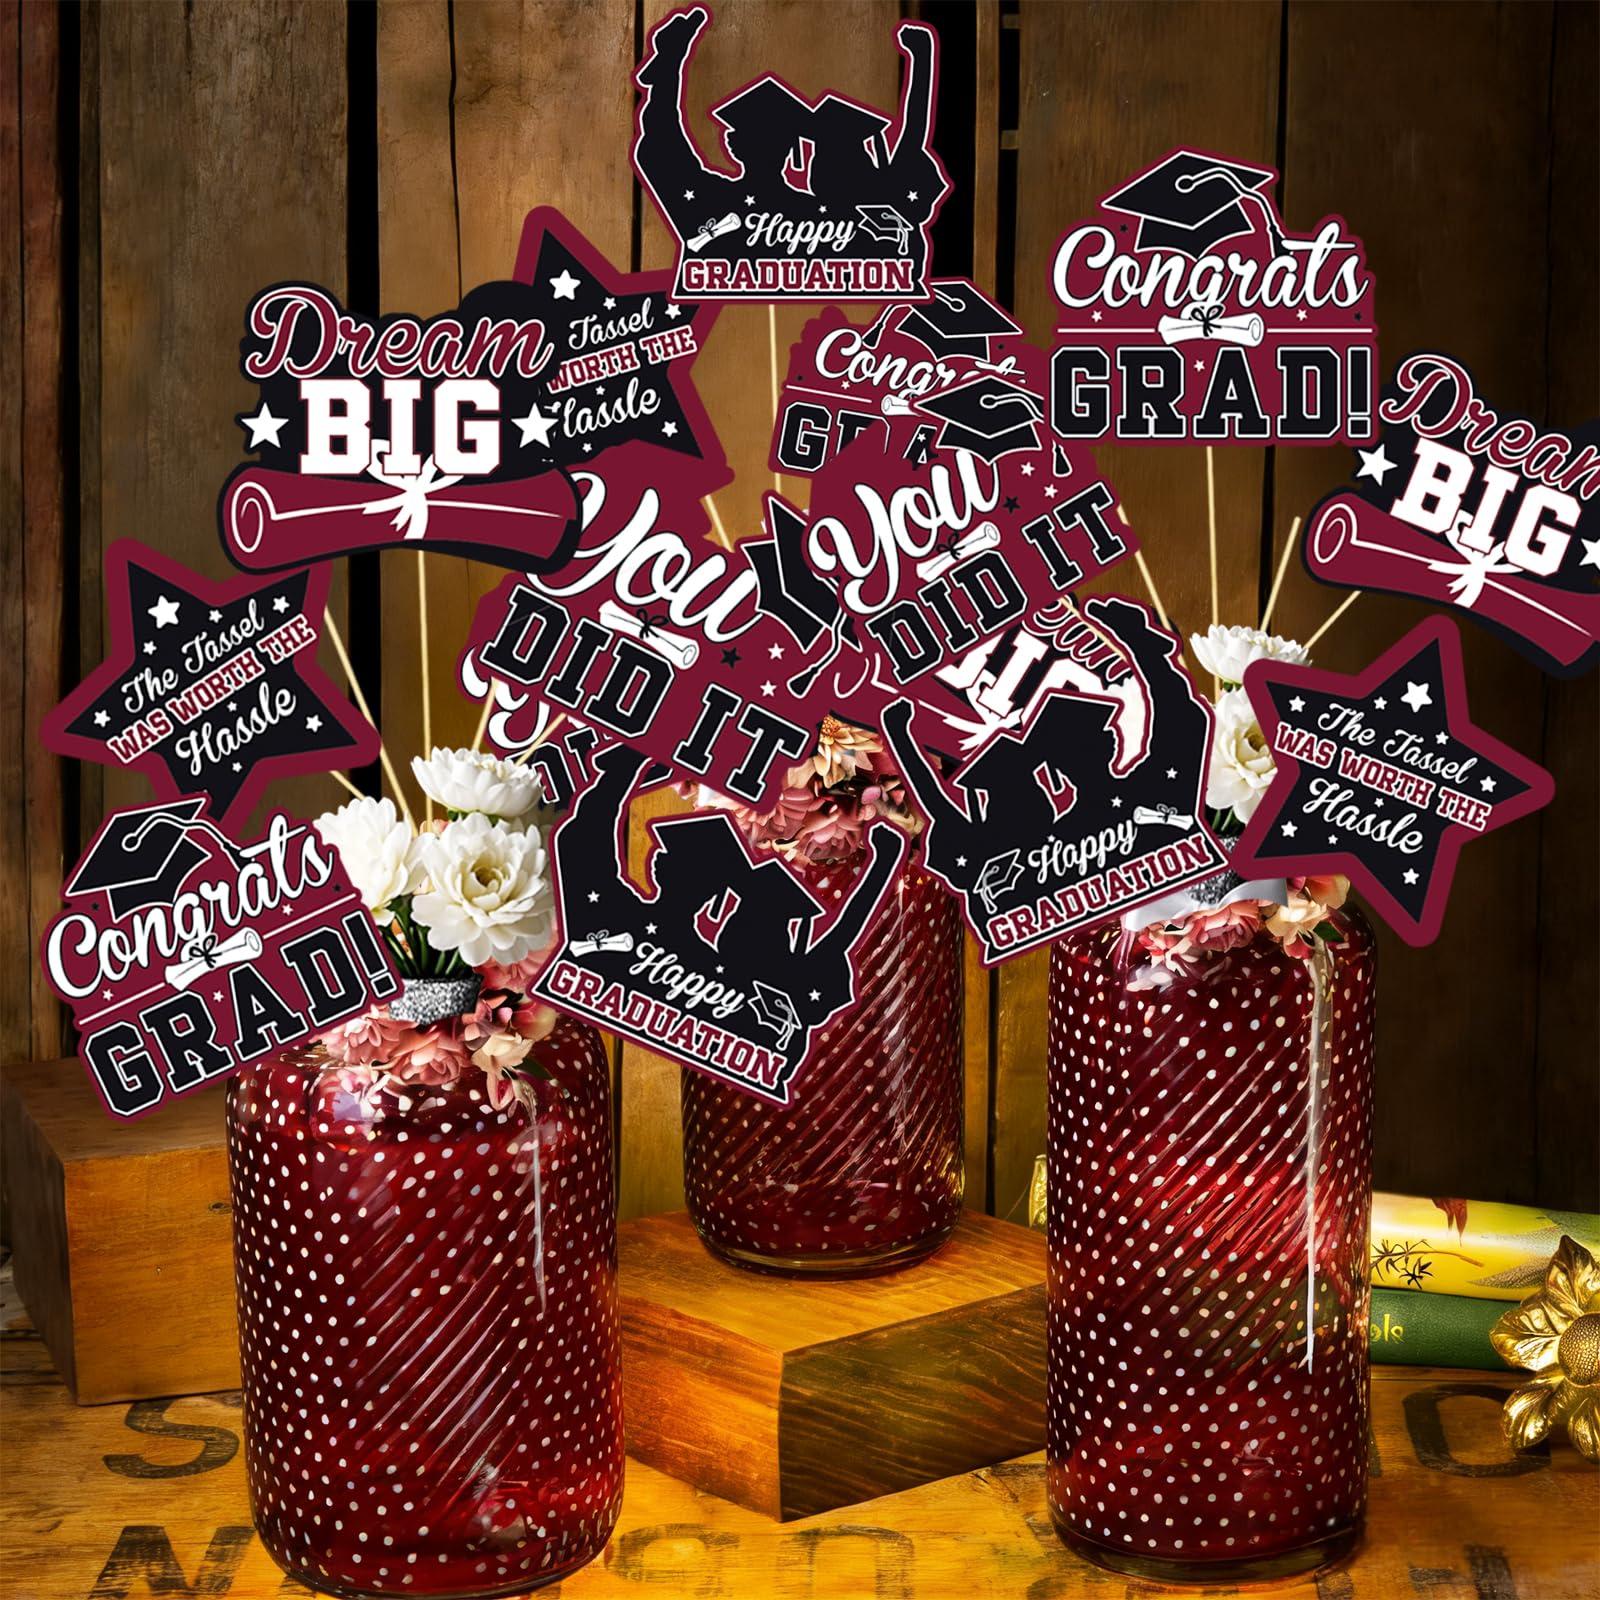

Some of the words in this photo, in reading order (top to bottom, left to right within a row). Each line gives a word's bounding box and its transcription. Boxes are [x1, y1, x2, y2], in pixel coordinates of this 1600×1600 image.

[682, 258, 914, 291] GRADUATION
[744, 212, 857, 254] Happy
[1052, 220, 1370, 320] Congrats
[245, 285, 555, 379] Dream
[568, 297, 655, 350] Tassel
[638, 324, 698, 365] THE
[815, 328, 1026, 402] Congr
[299, 378, 501, 476] BIG
[1050, 346, 1372, 439] GRAD!
[1378, 353, 1600, 500] Drea
[807, 447, 1000, 615] You
[1390, 436, 1583, 577] BIG
[526, 471, 764, 643] You
[865, 549, 1029, 685] DID
[1021, 480, 1127, 592] IT
[106, 708, 174, 765] WAS
[166, 647, 266, 725] WORTH
[258, 613, 317, 665] THE
[120, 667, 179, 714] The
[181, 598, 265, 674] Tassel
[479, 584, 677, 739] DID
[673, 683, 810, 804] IT
[174, 681, 297, 776] Hassle
[1275, 721, 1338, 770] WAS
[1337, 746, 1437, 810] WORTH
[1436, 787, 1494, 832] THE
[1317, 702, 1376, 747] The
[1383, 728, 1479, 784] Tassel
[1027, 819, 1139, 885] Happy
[1302, 777, 1424, 854] Hassle
[47, 814, 334, 998] Congrats
[987, 833, 1211, 950] GRADUATION
[85, 909, 399, 1117] GRAD!
[546, 960, 788, 1090] GRADUATION
[628, 941, 745, 1019] Happy
